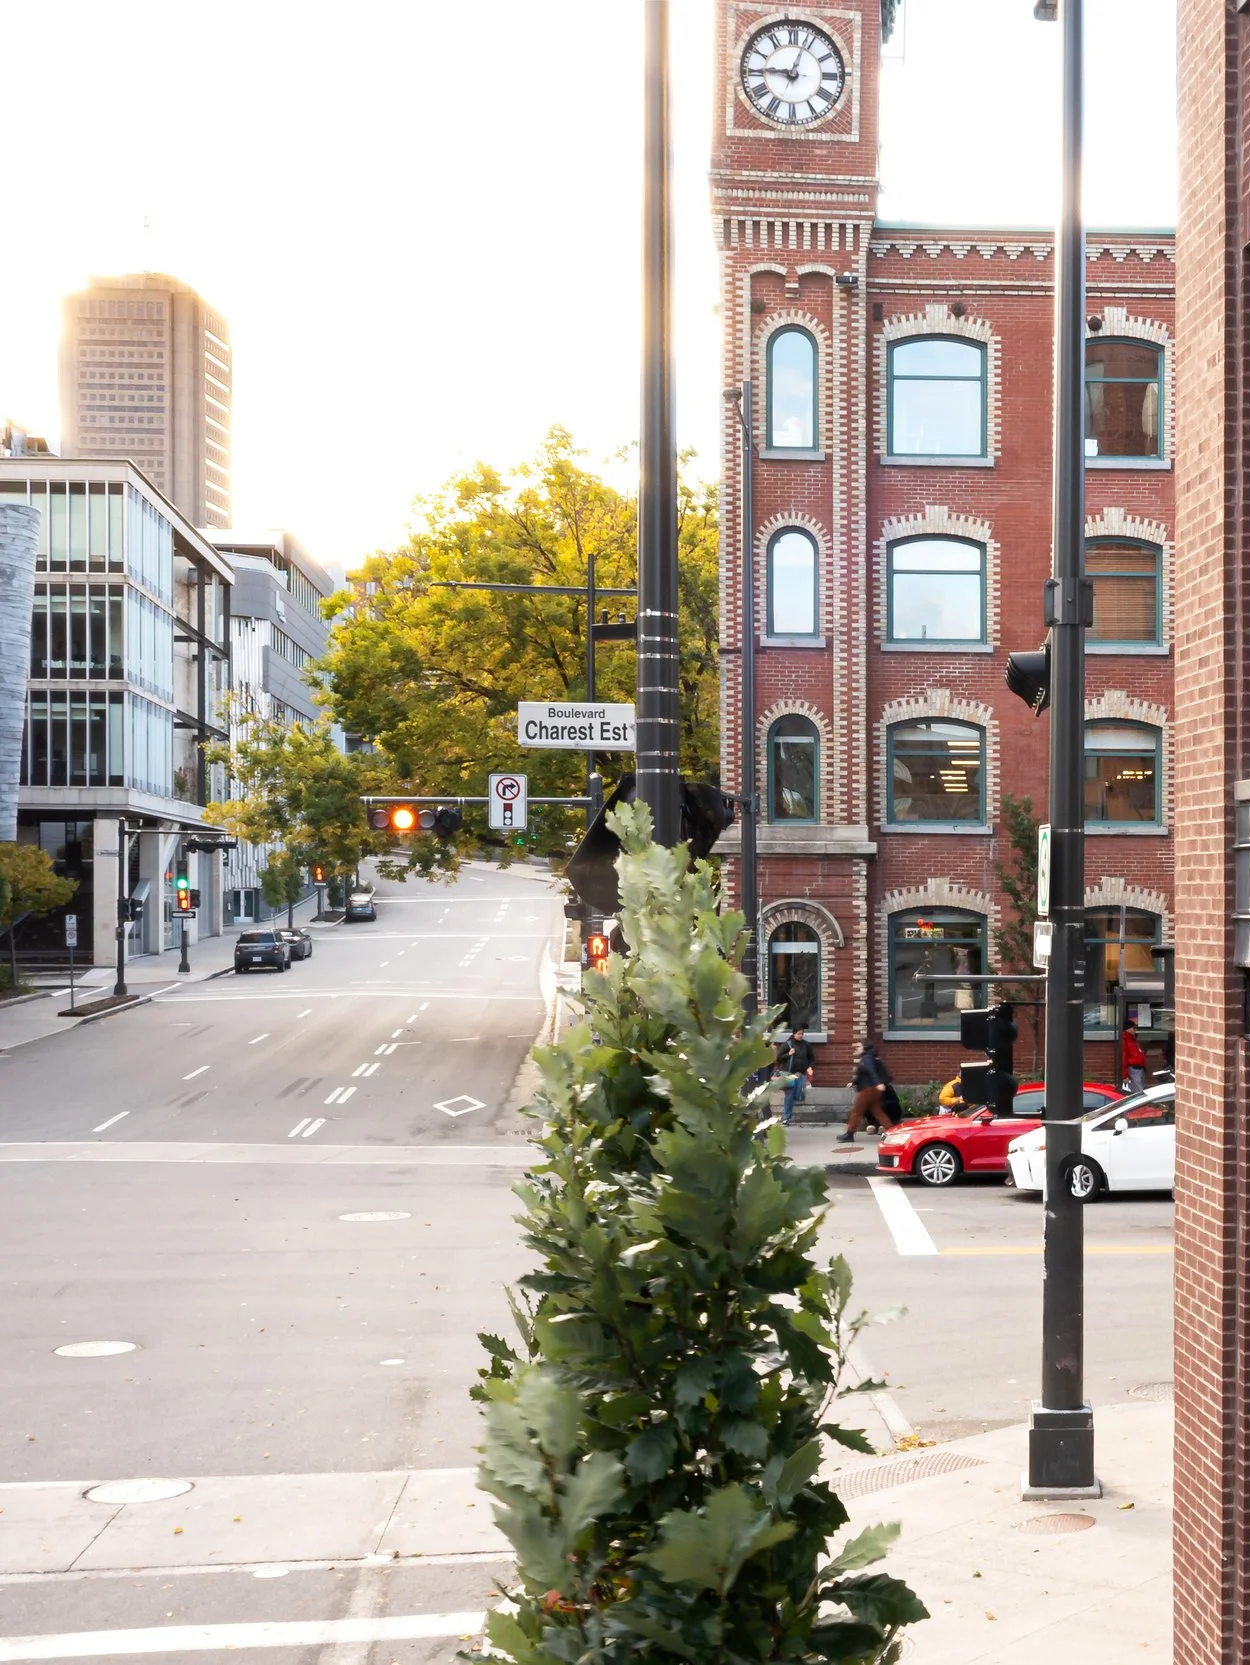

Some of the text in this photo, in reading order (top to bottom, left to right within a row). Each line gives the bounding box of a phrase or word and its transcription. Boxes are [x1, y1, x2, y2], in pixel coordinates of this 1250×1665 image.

[548, 708, 605, 719] Boulevard
[525, 720, 628, 741] Charest Est
